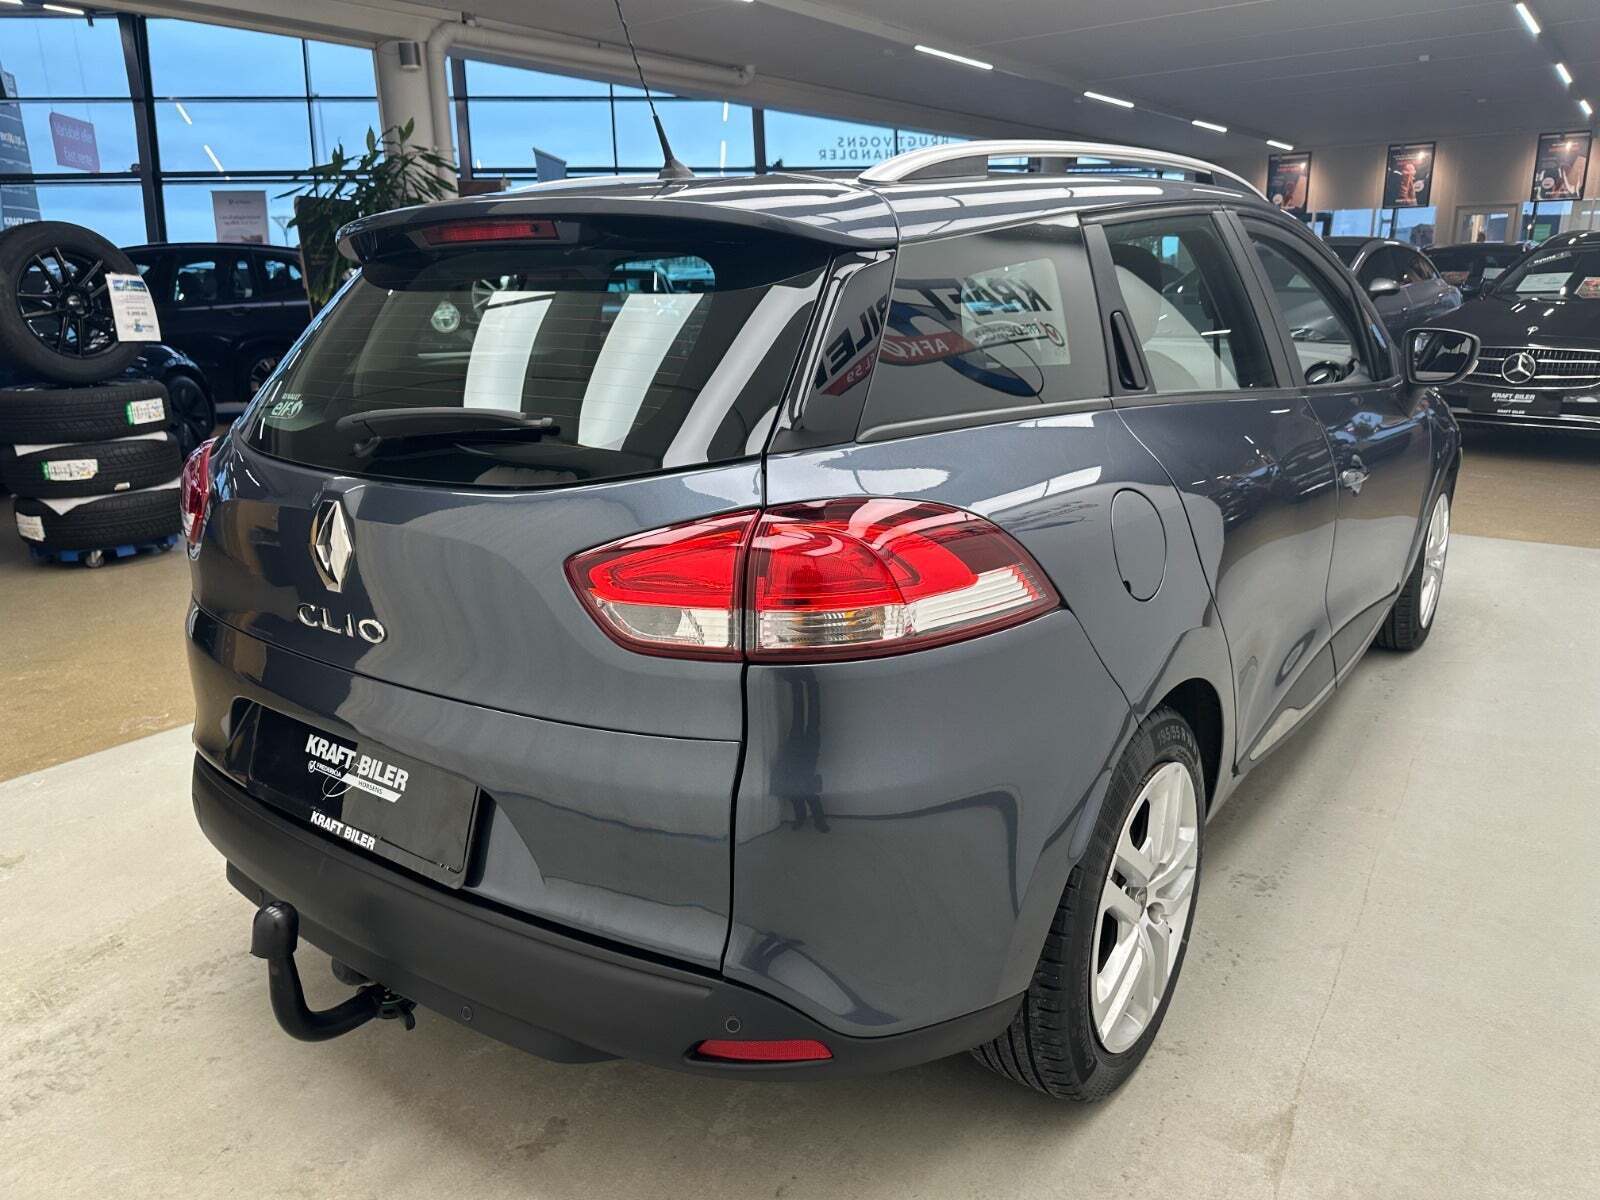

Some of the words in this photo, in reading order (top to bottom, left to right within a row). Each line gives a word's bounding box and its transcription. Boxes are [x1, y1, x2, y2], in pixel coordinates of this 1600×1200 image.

[298, 603, 385, 644] CLIO
[305, 734, 357, 770] KRAFT
[356, 754, 410, 792] BILER
[310, 810, 344, 835] KRAFT
[343, 825, 376, 851] BILER
